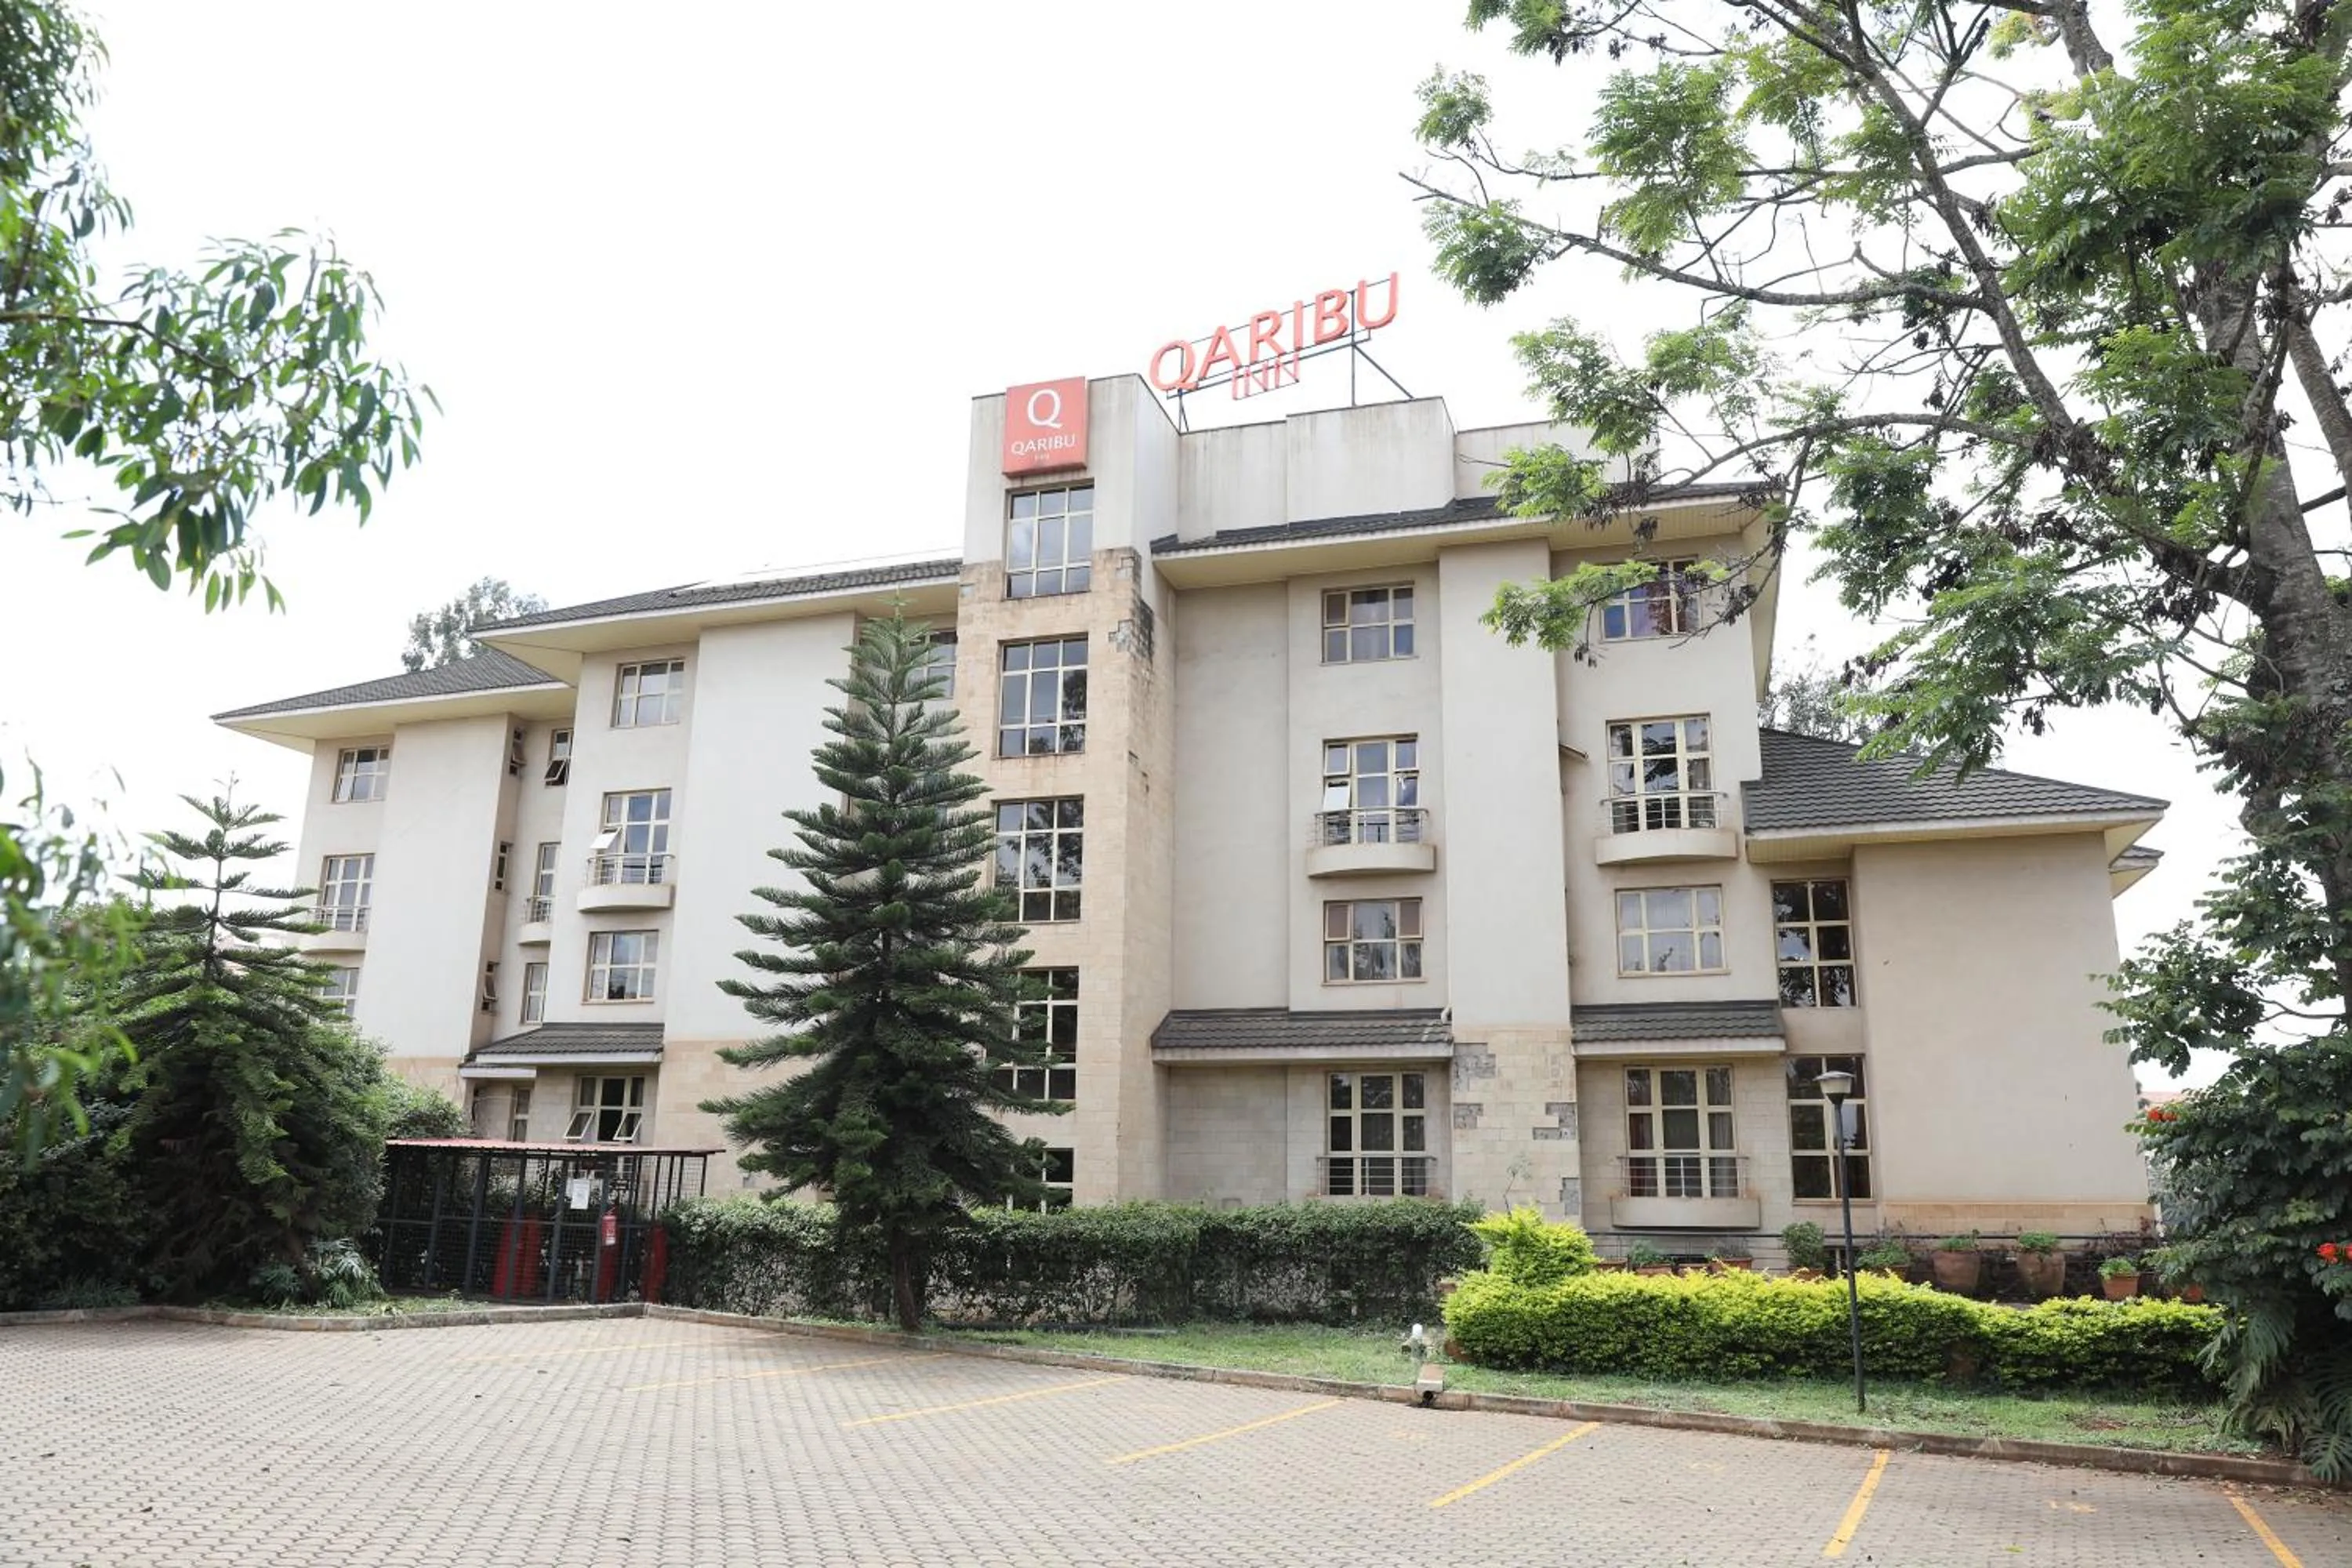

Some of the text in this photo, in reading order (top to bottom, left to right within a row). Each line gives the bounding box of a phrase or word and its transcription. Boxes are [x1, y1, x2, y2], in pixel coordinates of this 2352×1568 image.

[1149, 271, 1399, 391] QARIBU
[1231, 355, 1300, 401] INN
[1027, 389, 1062, 428] Q
[1011, 434, 1076, 456] QARIBU
